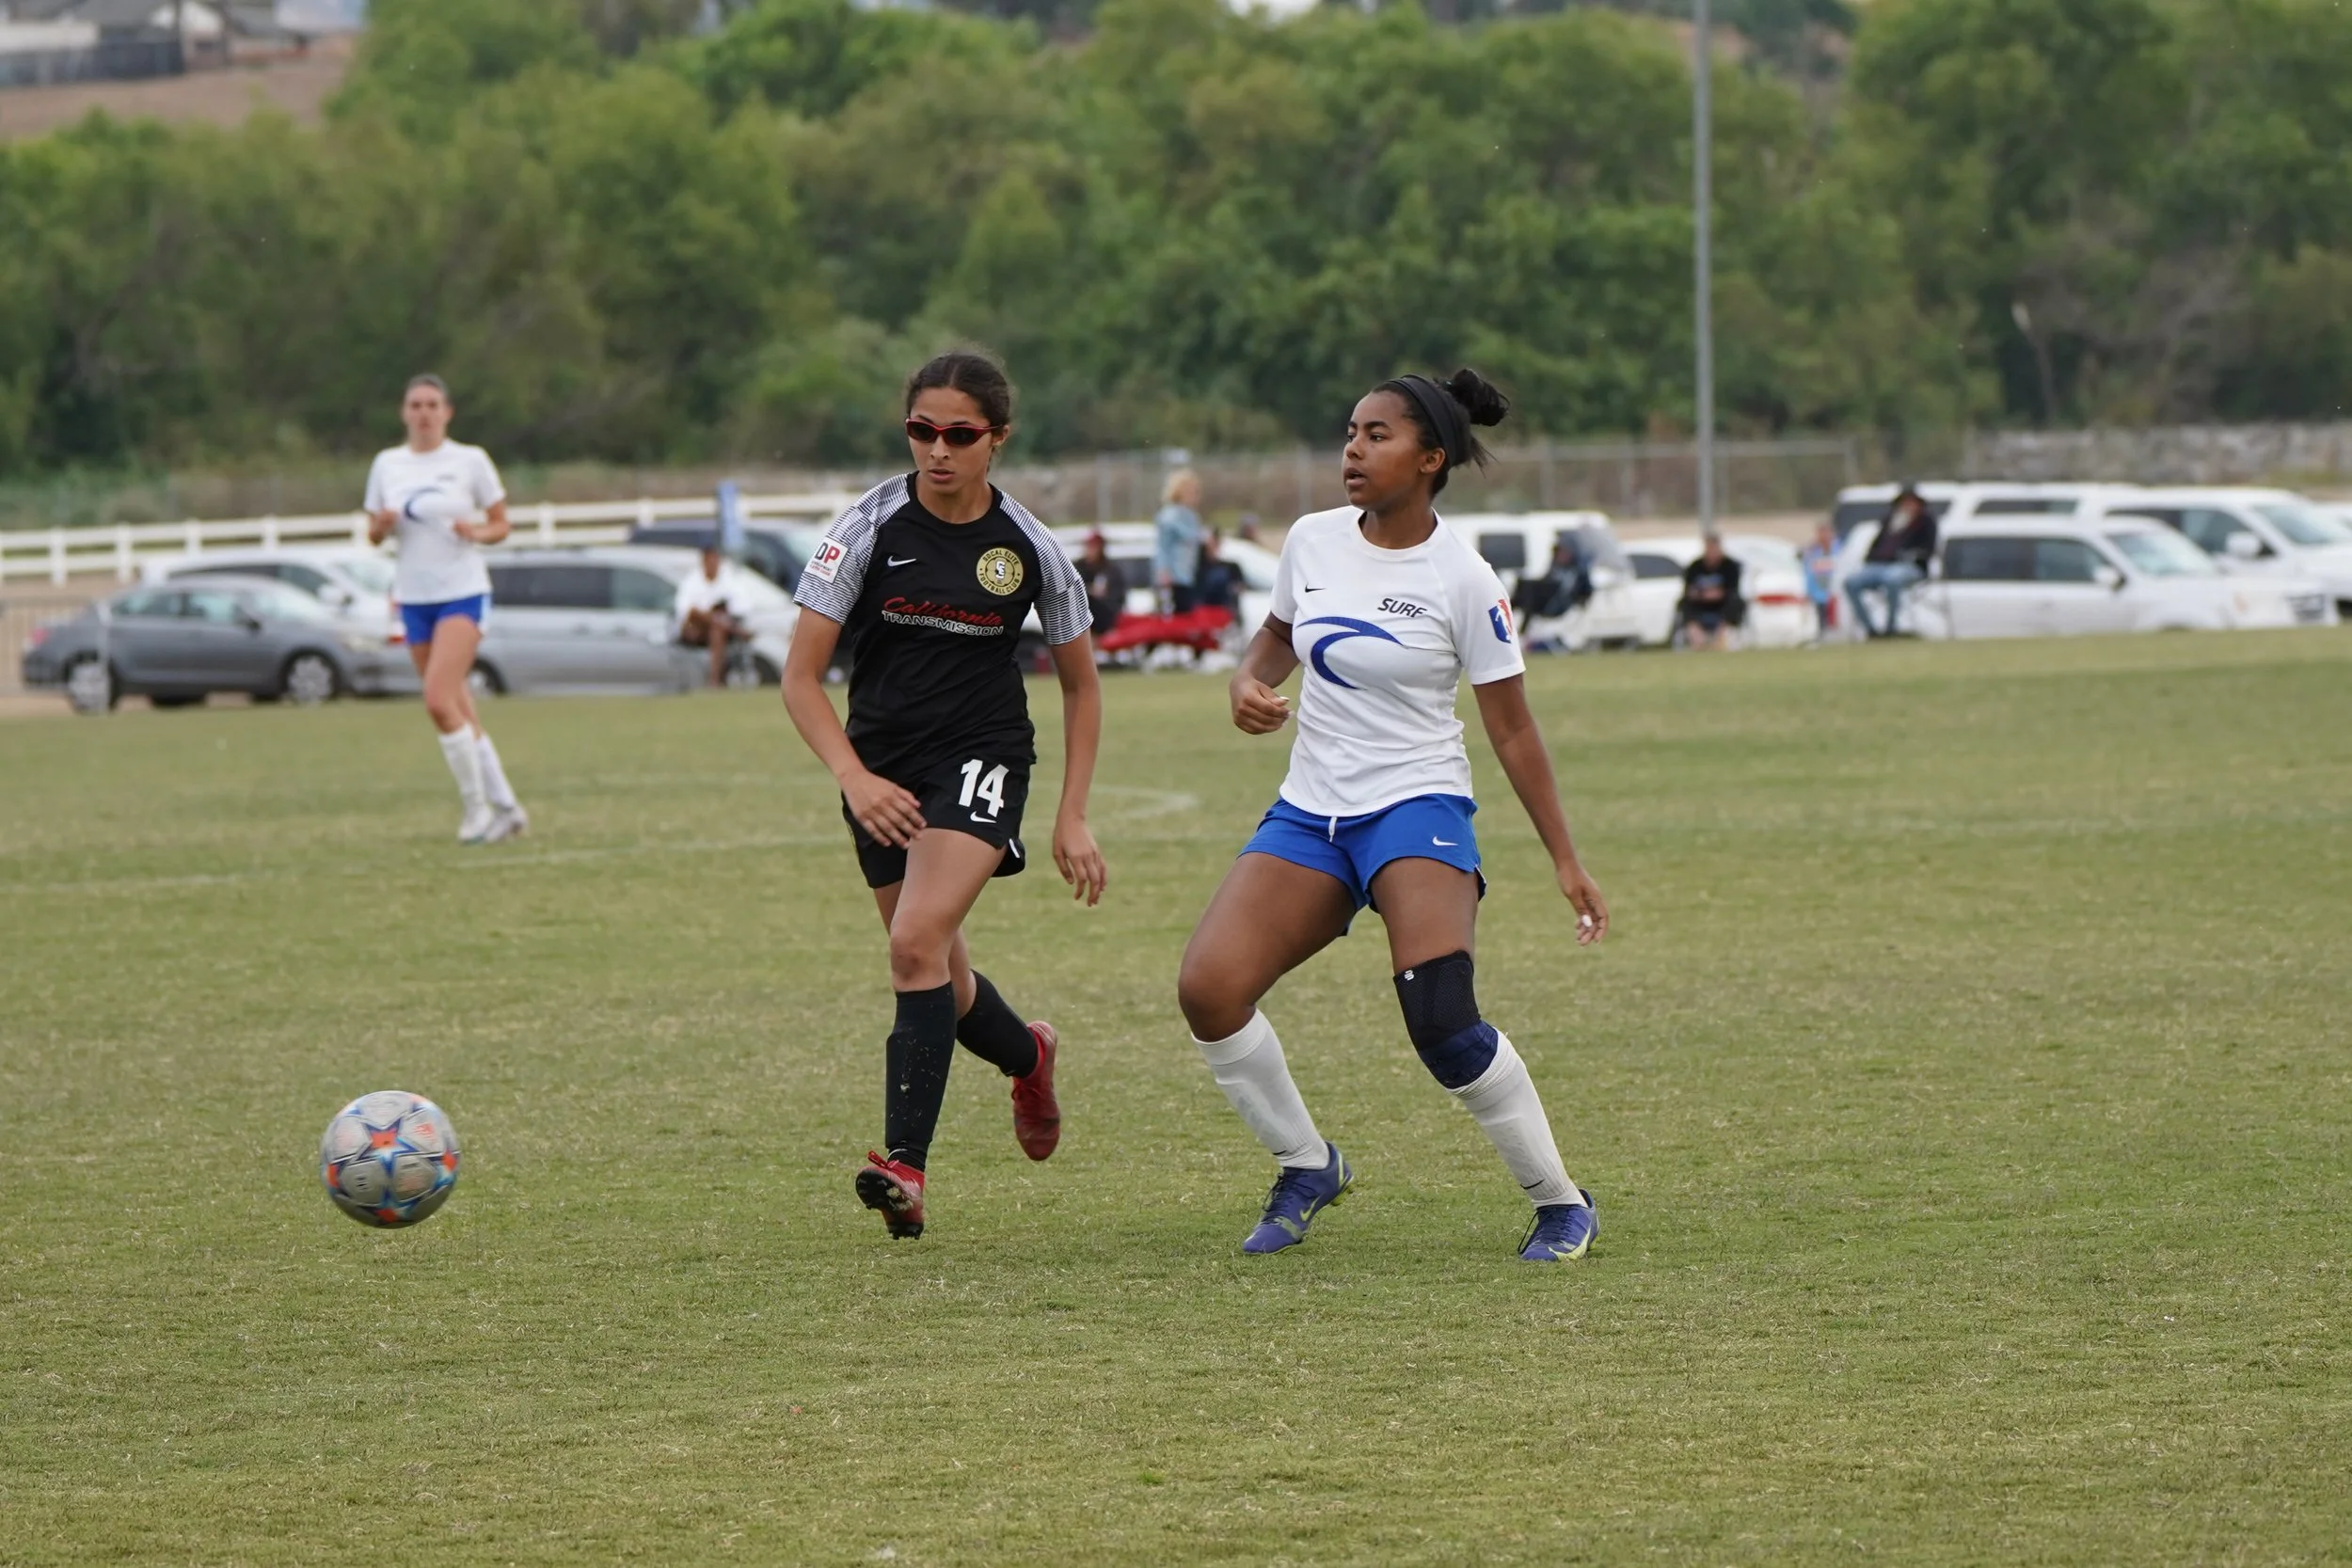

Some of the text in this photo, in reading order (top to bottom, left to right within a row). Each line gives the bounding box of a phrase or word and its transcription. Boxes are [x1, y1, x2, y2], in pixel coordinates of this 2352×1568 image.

[982, 550, 1020, 566] SOCAL ELITE
[979, 573, 1020, 594] FOOTBALL CLUB
[883, 596, 1003, 626] California
[1377, 597, 1428, 618] SURF
[882, 610, 1004, 636] TRANSMISSION
[958, 758, 1009, 818] 14
